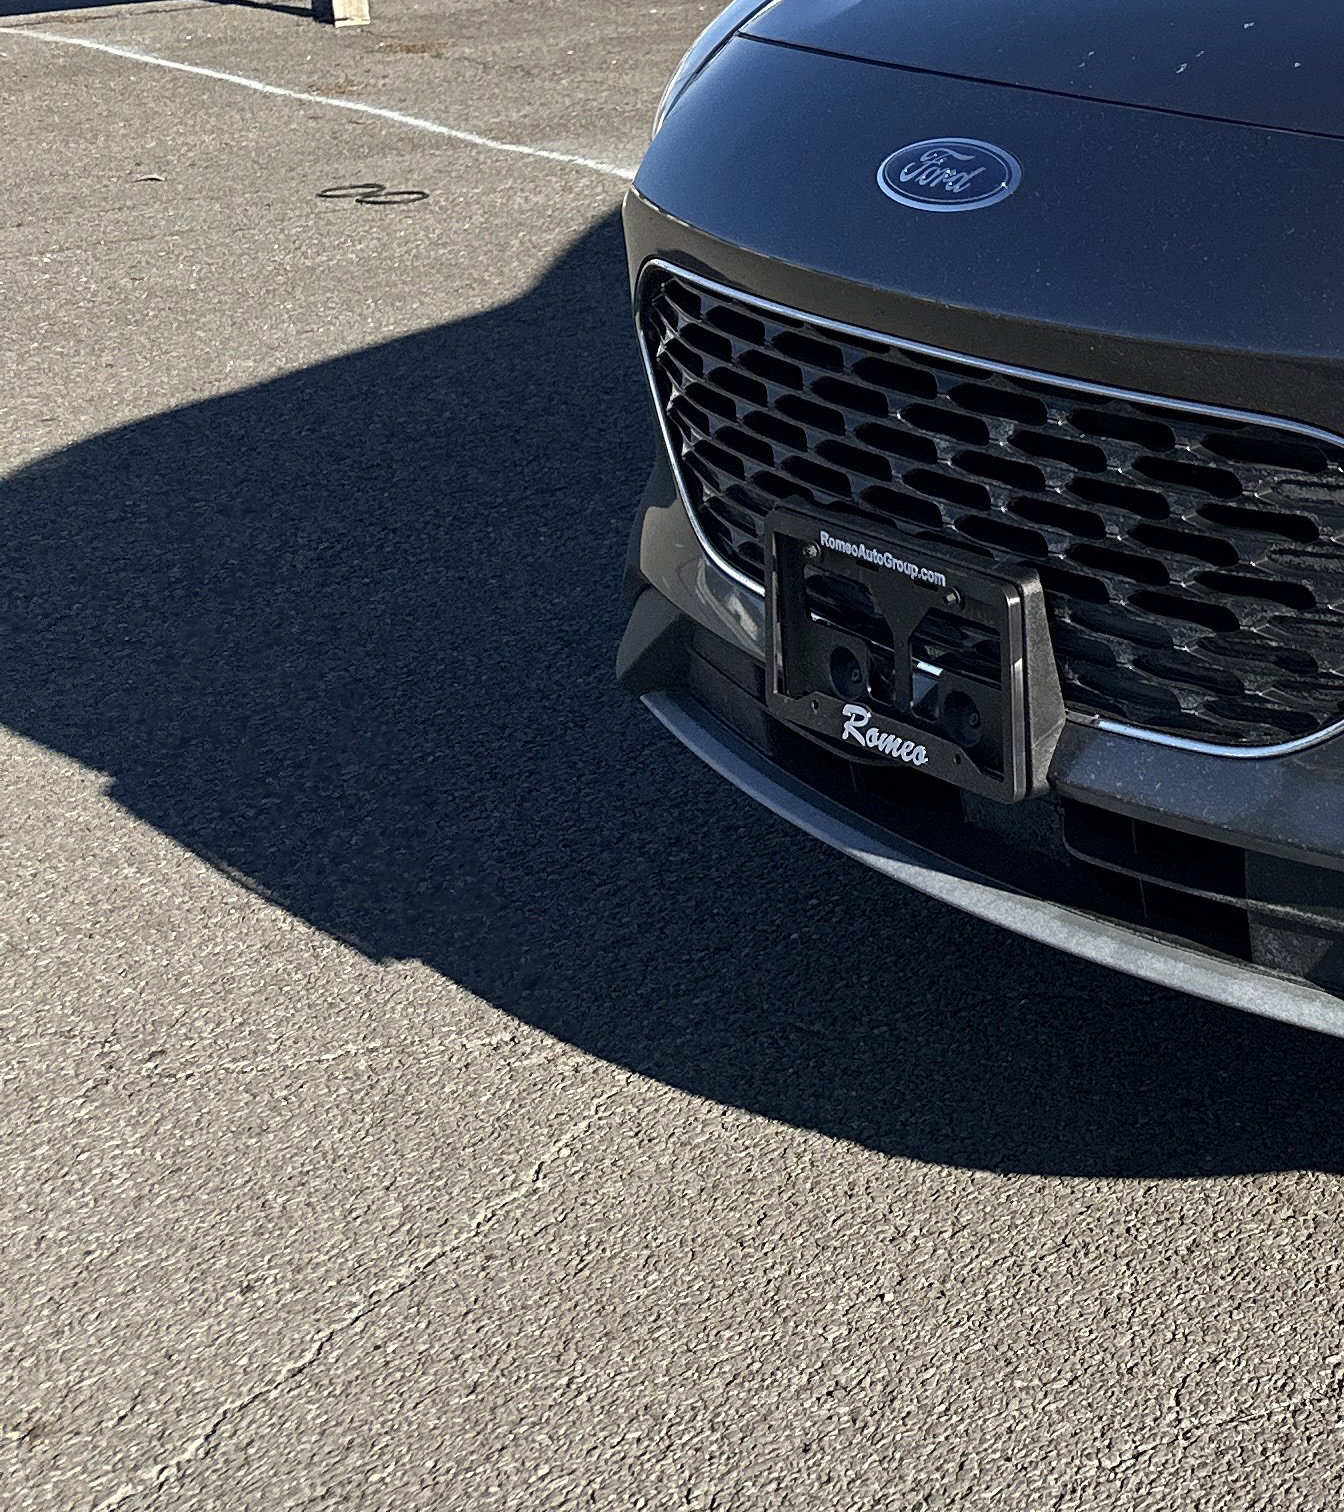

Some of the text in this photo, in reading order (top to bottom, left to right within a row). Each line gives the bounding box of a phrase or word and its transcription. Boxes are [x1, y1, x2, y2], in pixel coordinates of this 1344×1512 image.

[899, 147, 986, 194] Ford
[819, 530, 946, 588] RomeoAutoGroup.com
[841, 703, 929, 766] Romeo
